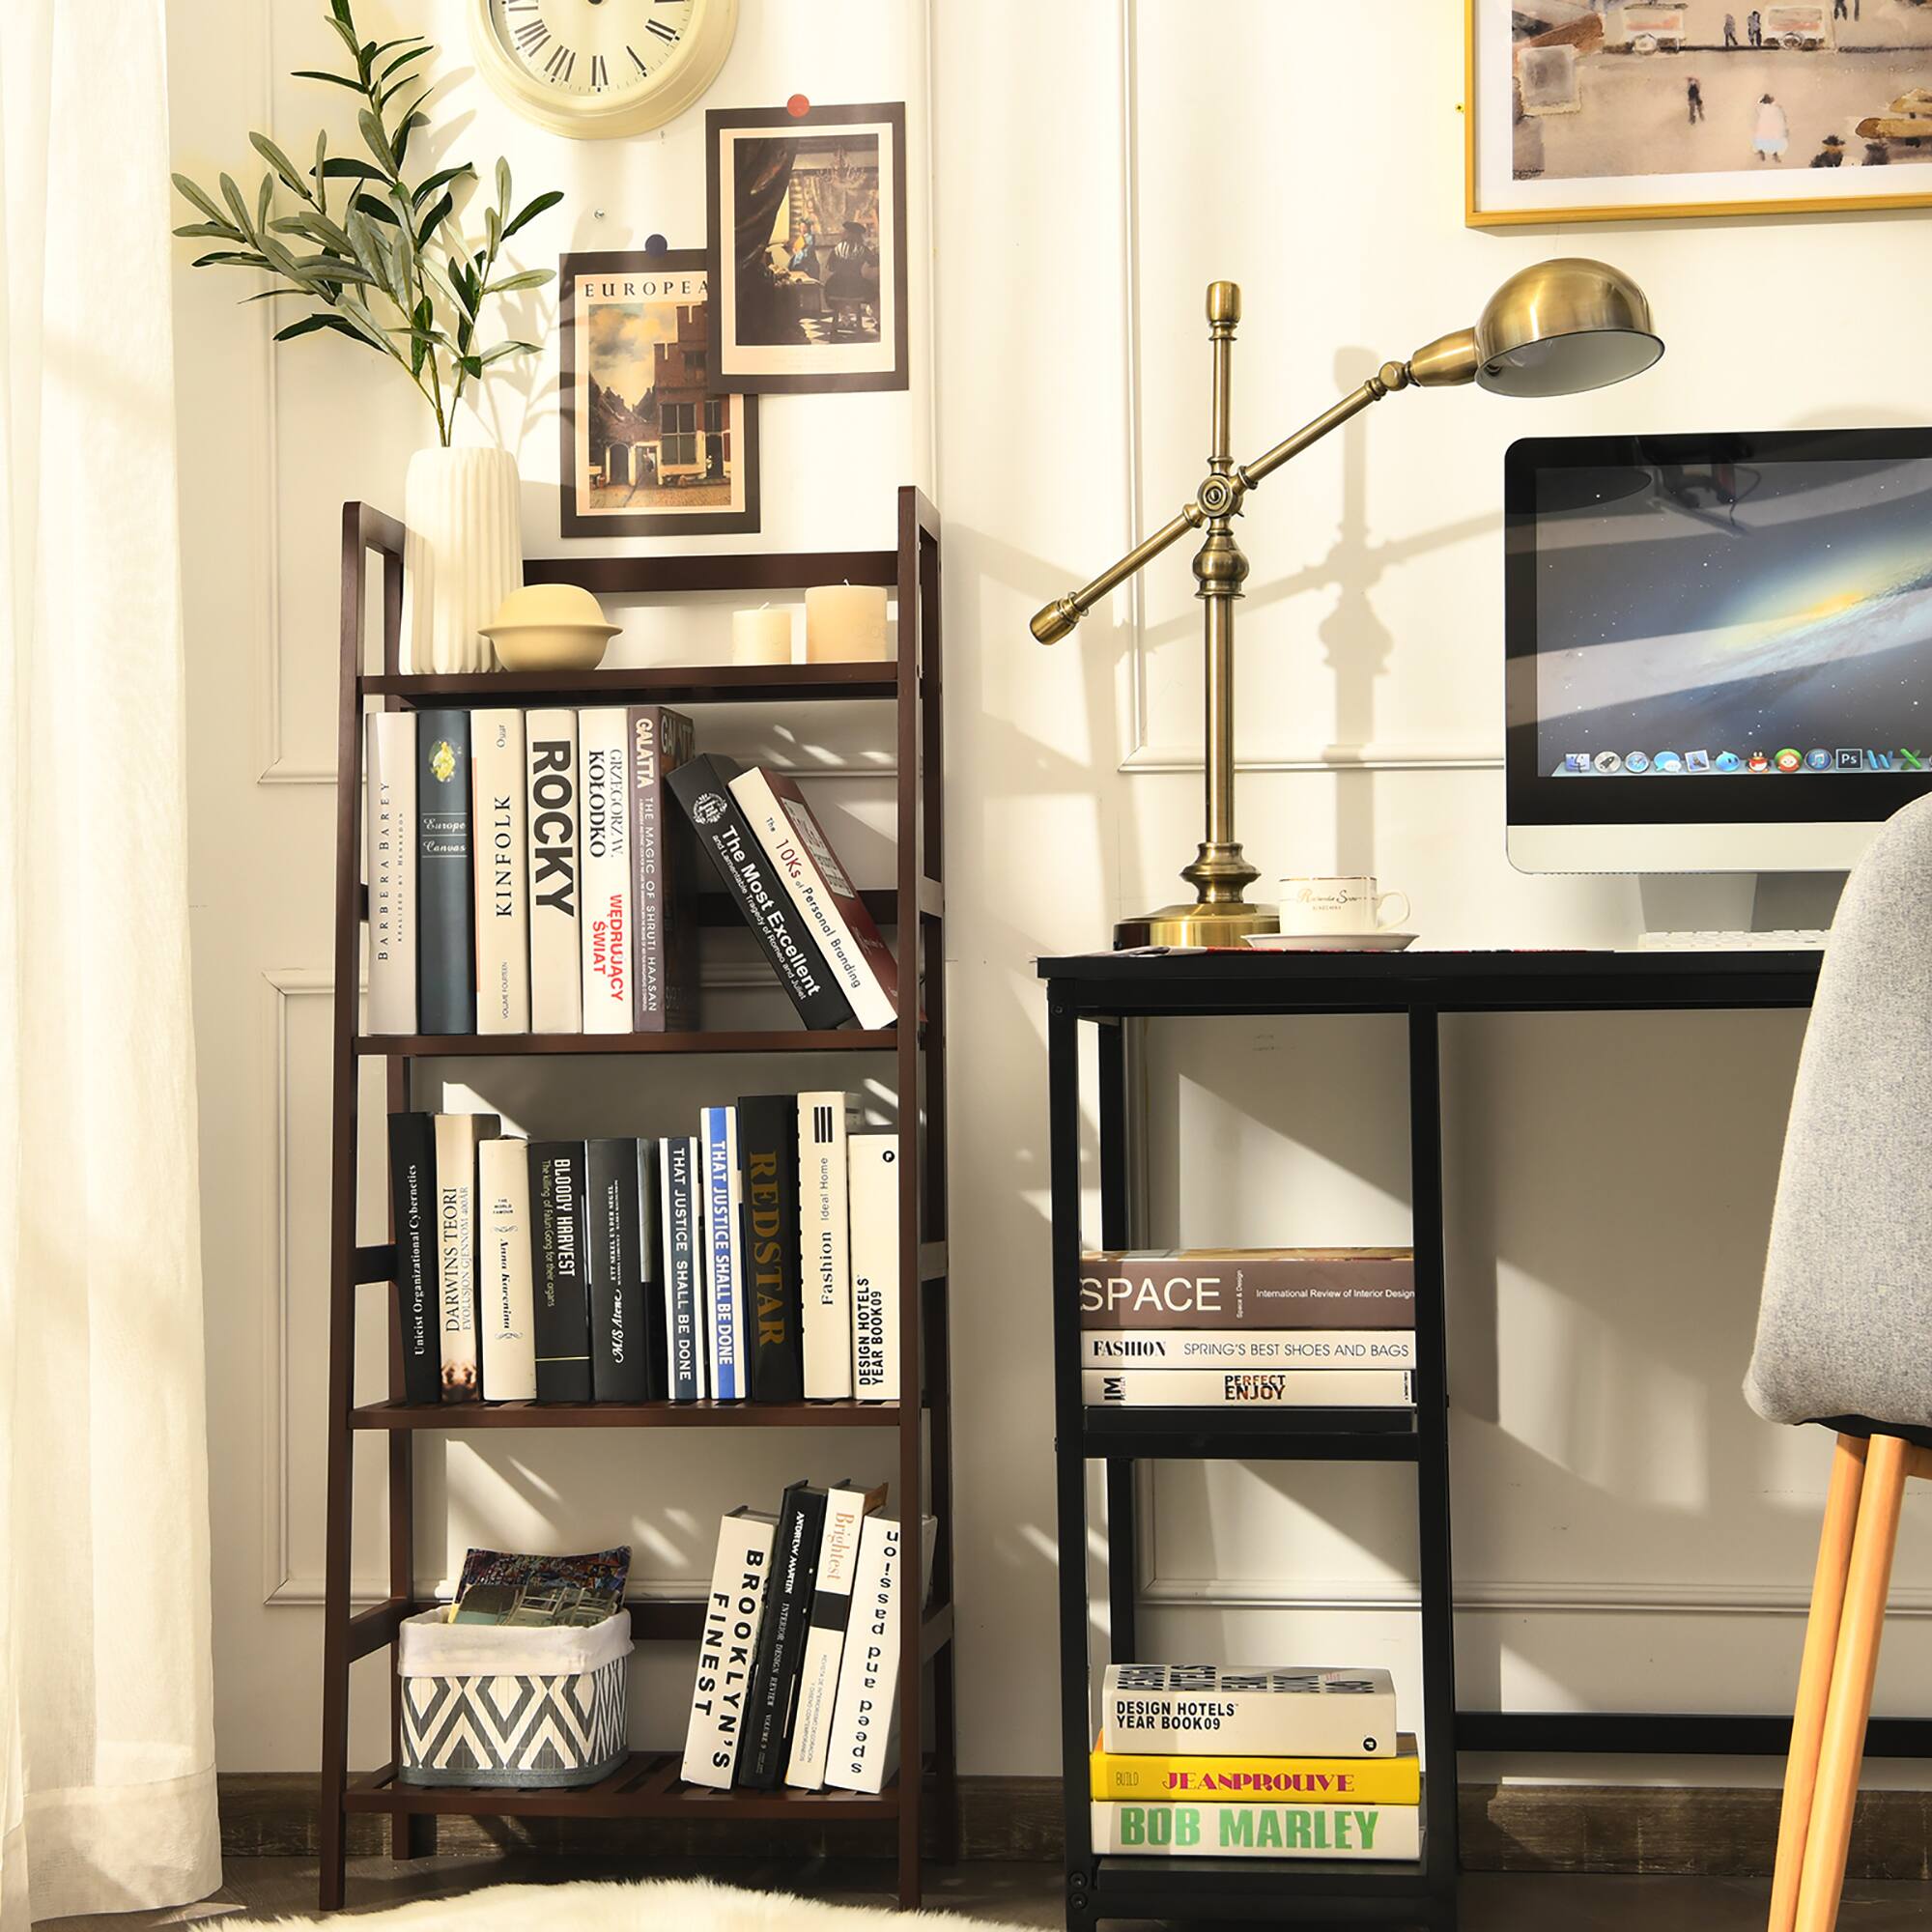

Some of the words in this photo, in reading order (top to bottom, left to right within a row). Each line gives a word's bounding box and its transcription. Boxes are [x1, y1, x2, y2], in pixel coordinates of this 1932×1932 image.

[636, 718, 654, 788] GALATTA
[1841, 753, 1857, 764] Ps
[379, 782, 389, 850] BAREY
[589, 750, 606, 858] KOŁODKO
[610, 749, 623, 836] GRZEGORZ
[645, 797, 654, 820] THE
[422, 839, 467, 852] Canvas
[423, 818, 466, 834] Europe
[532, 740, 575, 918] ROCKY
[494, 795, 513, 918] KINFOLK
[645, 827, 655, 874] MAGIC
[378, 861, 389, 960] BARBERA
[646, 881, 655, 898] OF
[722, 824, 746, 863] The
[741, 862, 775, 912] Most
[767, 910, 821, 997] Excellent
[766, 817, 776, 833] The
[776, 838, 802, 879] 10Ks
[802, 887, 837, 937] Personal
[830, 938, 862, 989] Branding
[646, 905, 656, 950] SHRUTI
[712, 835, 724, 850] and
[721, 848, 747, 895] Lamentable
[746, 894, 766, 926] Tragedy
[762, 924, 772, 937] of
[767, 935, 785, 963] Romeo
[782, 963, 794, 978] and
[791, 978, 807, 1000] Juliet
[593, 921, 609, 975] ŚWIAT
[607, 894, 623, 1001] WĘDRUJĄCY
[647, 956, 657, 1011] HAASAN
[542, 1160, 552, 1175] The
[673, 1148, 685, 1184] THAT
[712, 1141, 726, 1181] THAT
[820, 1157, 829, 1189] Home
[407, 1164, 422, 1229] Cybernetics
[554, 1159, 573, 1211] BLOODY
[821, 1194, 830, 1221] Ideal
[442, 1188, 459, 1242] TEORI
[675, 1190, 688, 1251] JUSTICE
[714, 1187, 729, 1249] JUSTICE
[500, 1238, 509, 1269] Anna
[556, 1216, 576, 1276] HARVEST
[750, 1151, 786, 1347] REDSTAR
[819, 1232, 833, 1305] Fashion
[410, 1232, 424, 1313] Organizational
[444, 1246, 460, 1332] DARWINS
[676, 1261, 689, 1309] SHALL
[715, 1255, 731, 1300] SHALL
[1079, 1278, 1222, 1312] SPACE
[1256, 1289, 1308, 1297] International
[1310, 1289, 1342, 1297] Review
[1343, 1289, 1352, 1297] of
[1353, 1289, 1383, 1297] Interior
[1385, 1289, 1415, 1299] Design
[461, 1271, 472, 1331] EVOLUSJON
[501, 1273, 512, 1329] Karenina
[678, 1315, 690, 1334] BE
[717, 1304, 731, 1321] BE
[414, 1315, 425, 1356] Unicist
[718, 1324, 733, 1364] DONE
[1094, 1340, 1167, 1356] FASHION
[1183, 1343, 1246, 1356] SPRING'S
[1250, 1344, 1280, 1356] BEST
[1284, 1344, 1330, 1356] SHOES
[1334, 1344, 1366, 1356] AND
[1371, 1344, 1409, 1357] BAGS
[679, 1339, 692, 1380] DONE
[859, 1336, 870, 1386] DESIGN
[870, 1349, 884, 1386] YEAR
[1225, 1376, 1287, 1385] PERFECT
[1224, 1385, 1287, 1400] ENJOY
[827, 1512, 855, 1579] Brightest
[695, 1593, 729, 1716] FINEST
[712, 1549, 764, 1768] BROOKLYN'S
[1117, 1701, 1171, 1715] DESIGN
[1117, 1716, 1155, 1729] YEAR
[1116, 1772, 1139, 1786] BUILD
[1162, 1772, 1354, 1792] JEANPROUVE
[1121, 1807, 1200, 1846] BOB
[1219, 1808, 1378, 1850] MARLEY
